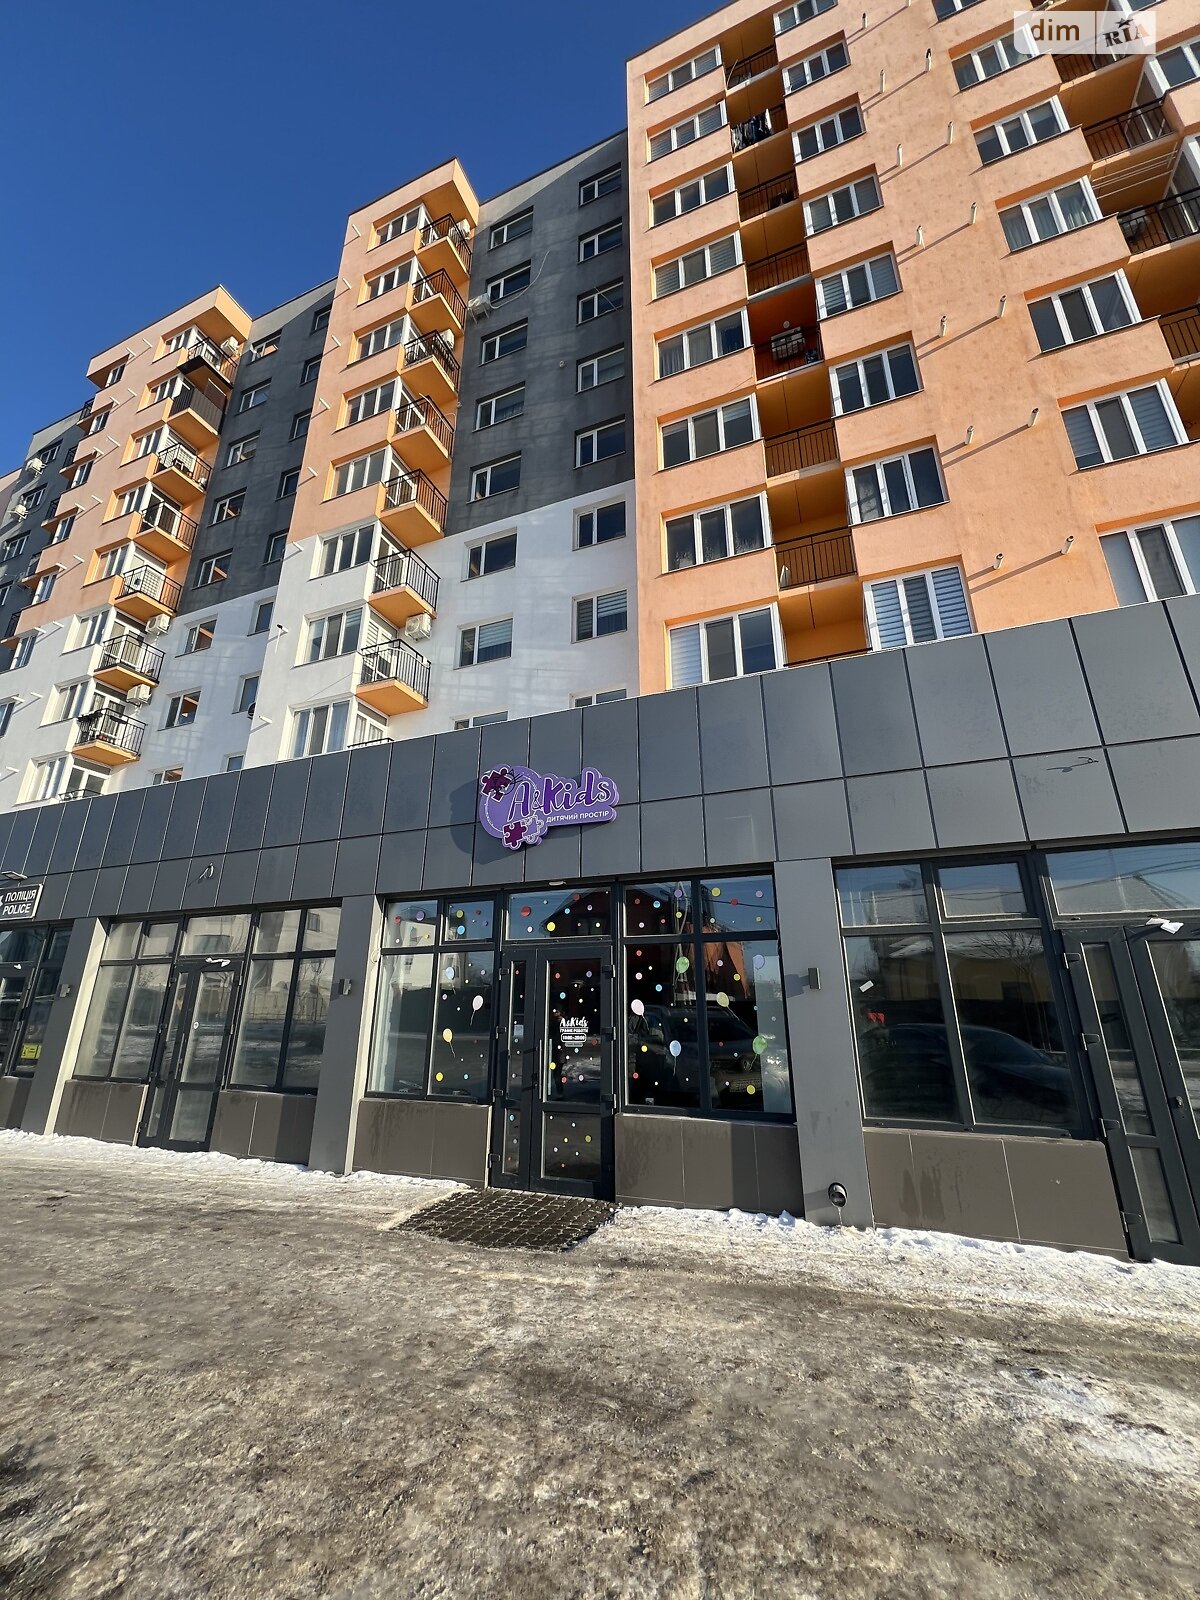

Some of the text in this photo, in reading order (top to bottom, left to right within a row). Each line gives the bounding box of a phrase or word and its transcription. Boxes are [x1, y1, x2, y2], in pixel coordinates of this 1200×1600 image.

[546, 810, 610, 824] ДИТЯЧИЙ ПРОСТІР
[4, 889, 37, 902] ПОЛІЦІЯ
[2, 903, 32, 916] POLICE
